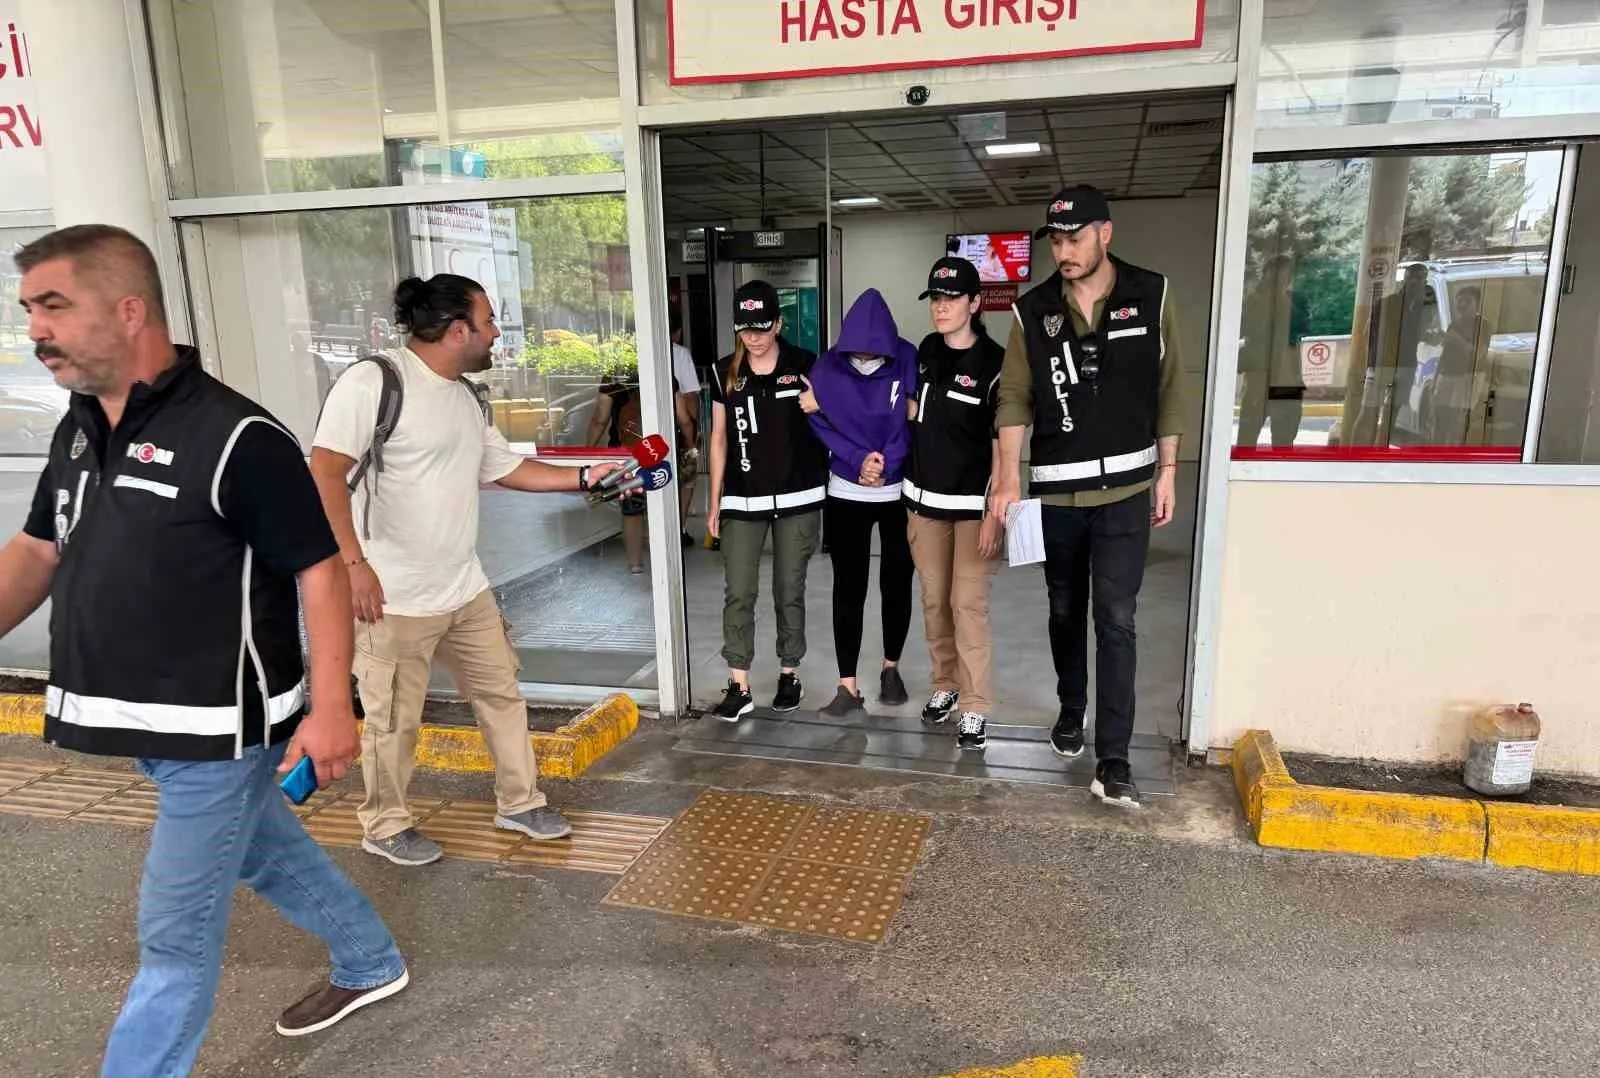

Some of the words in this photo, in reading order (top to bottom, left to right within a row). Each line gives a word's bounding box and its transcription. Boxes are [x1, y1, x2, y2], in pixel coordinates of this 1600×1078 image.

[781, 0, 921, 43] HASTA
[1050, 356, 1074, 432] POLİS
[734, 406, 751, 472] POLİS
